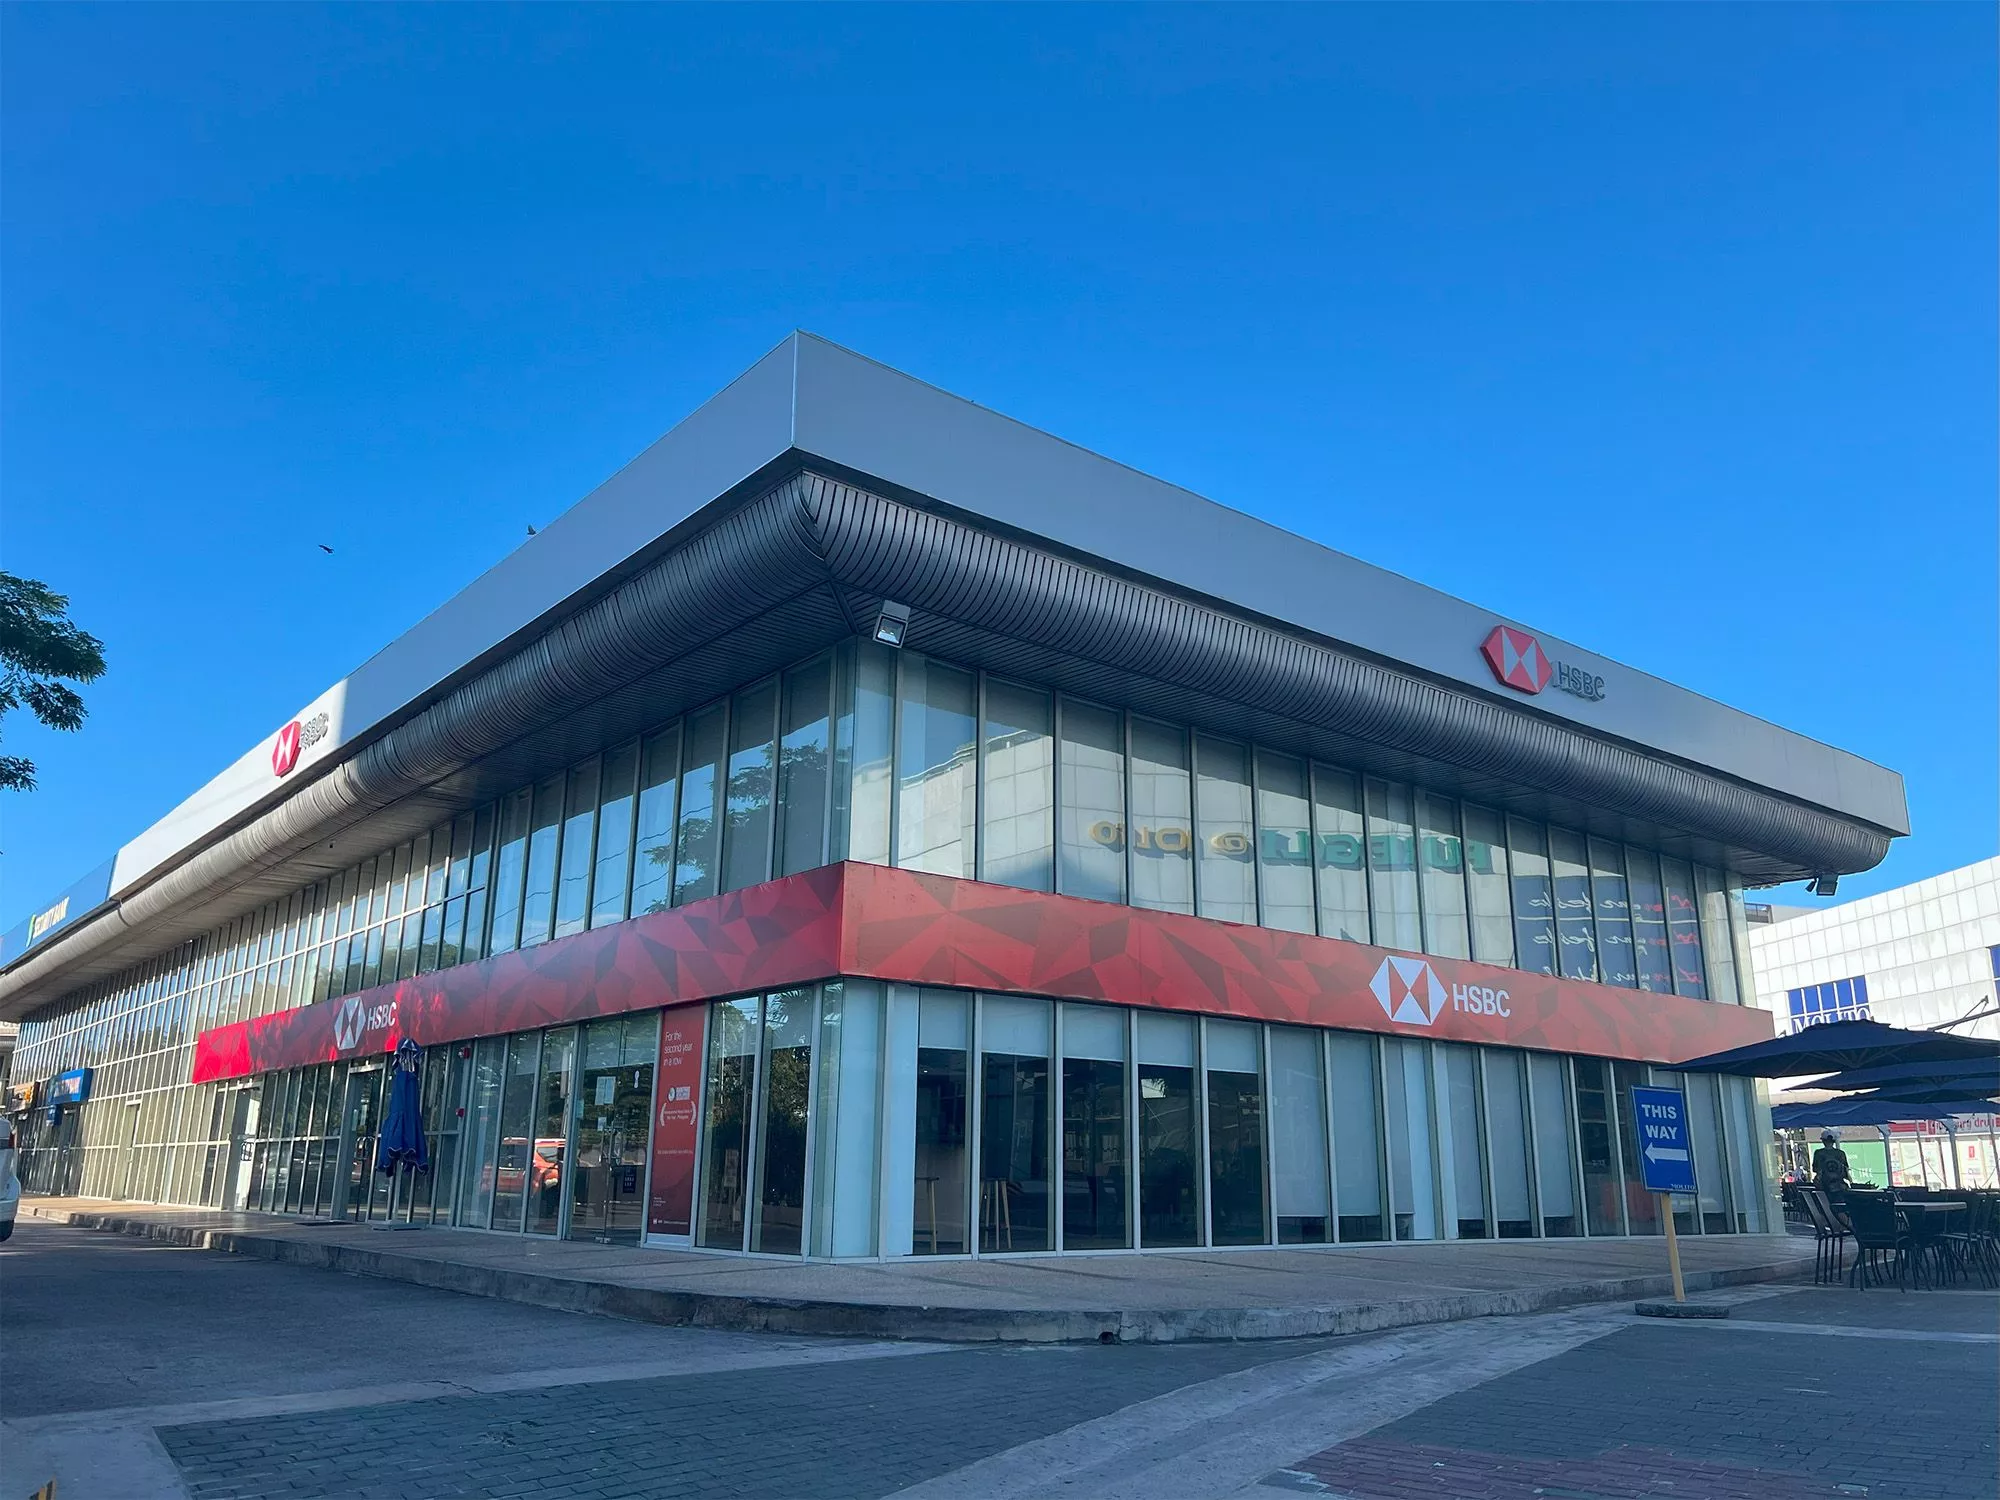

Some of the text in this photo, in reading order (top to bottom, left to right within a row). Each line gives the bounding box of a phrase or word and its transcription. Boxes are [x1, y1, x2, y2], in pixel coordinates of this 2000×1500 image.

[1557, 661, 1606, 699] HSBC
[1452, 983, 1511, 1018] HSBC
[367, 1002, 397, 1031] HSBC
[1641, 1104, 1677, 1119] THIS
[1645, 1125, 1678, 1140] WAY
